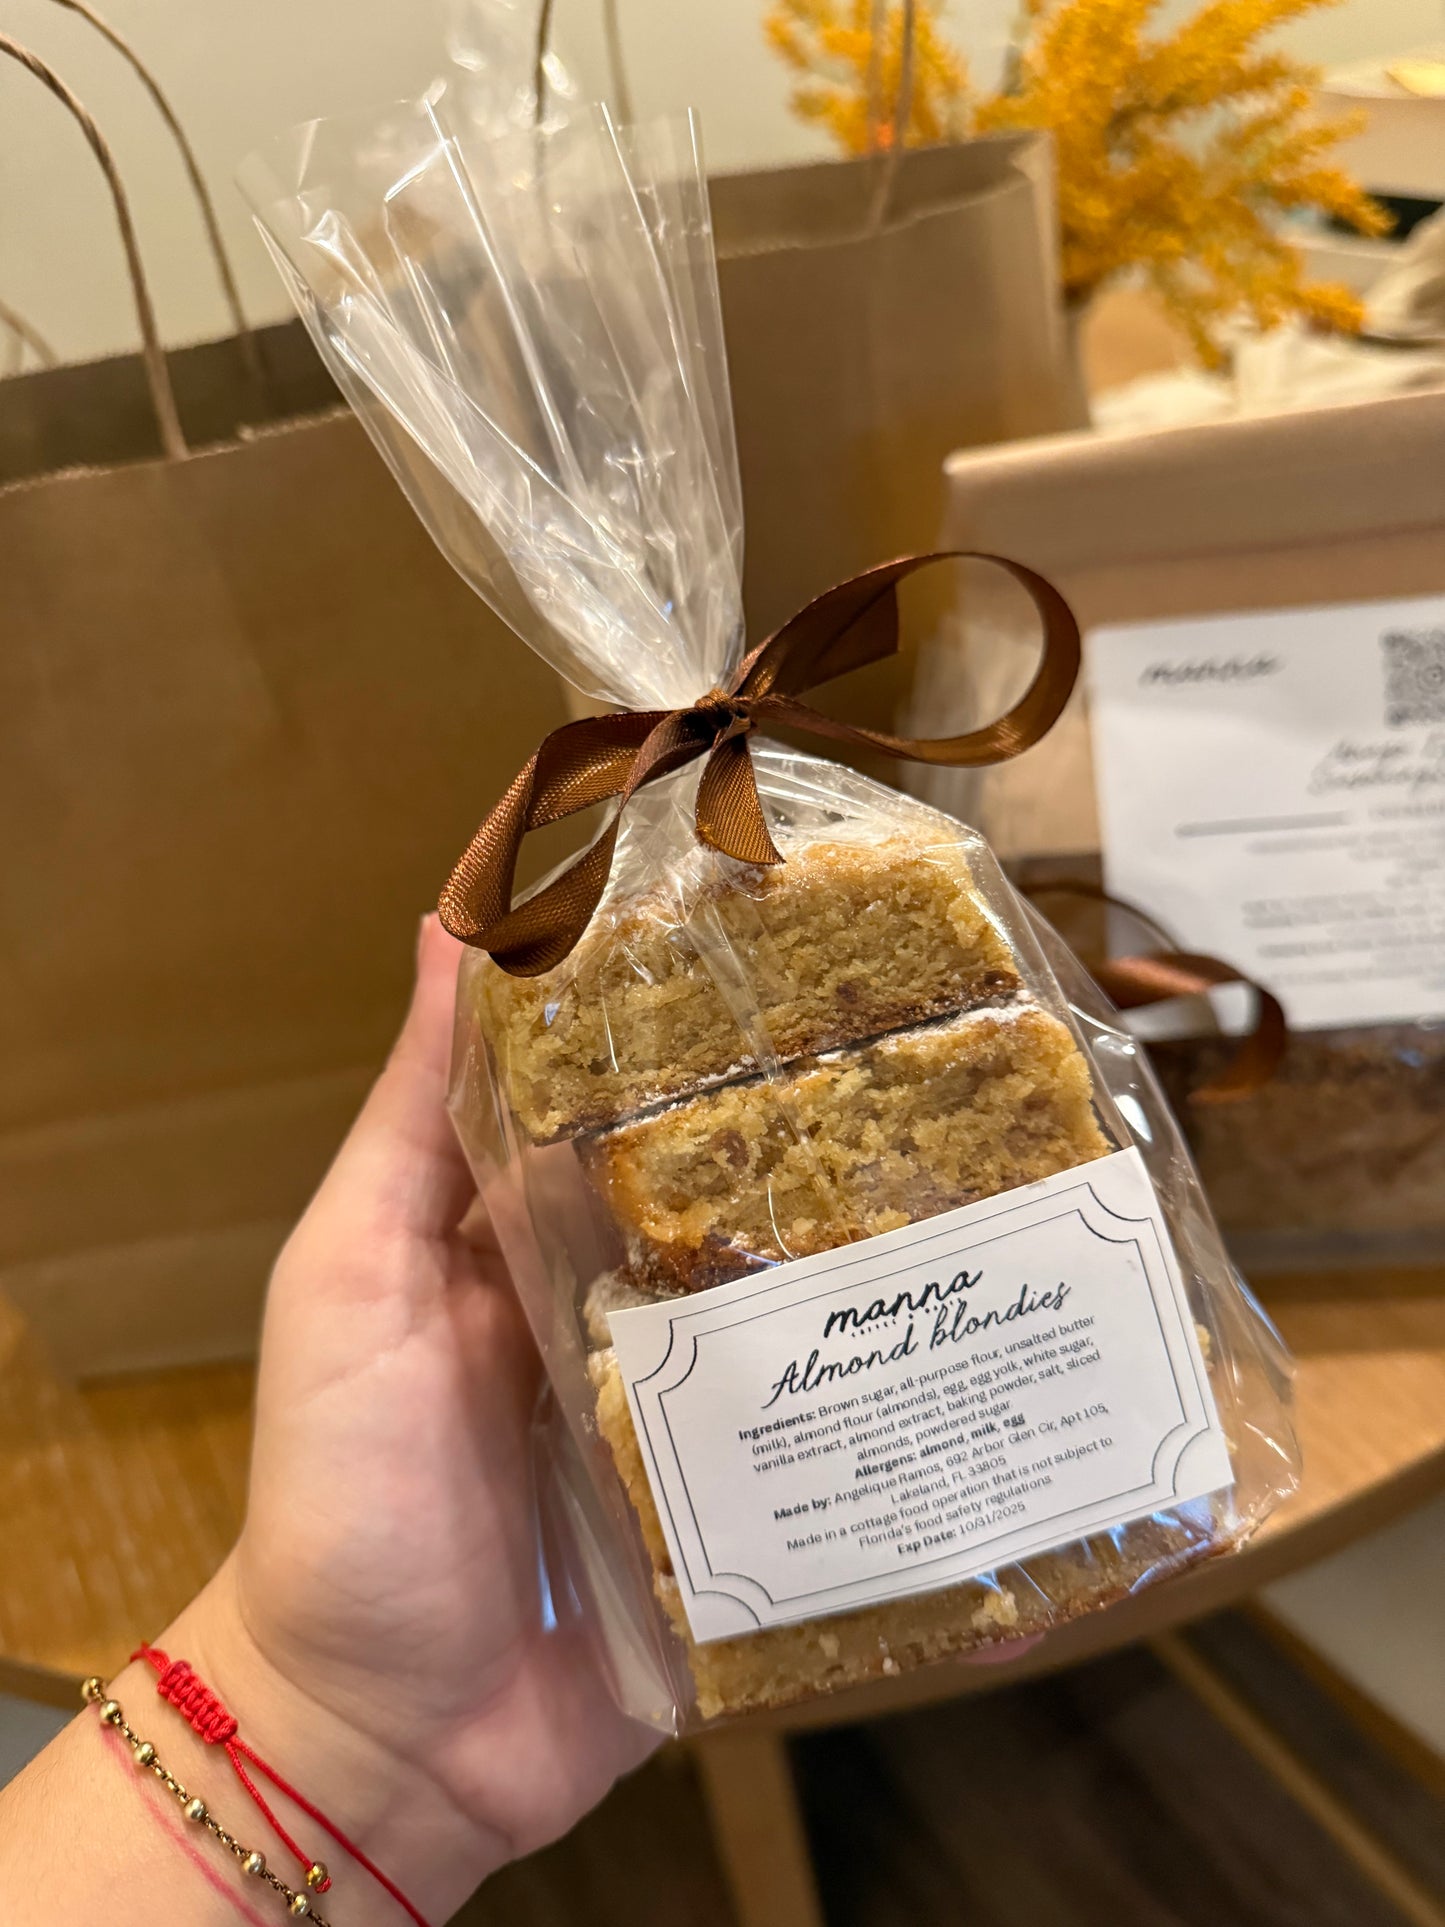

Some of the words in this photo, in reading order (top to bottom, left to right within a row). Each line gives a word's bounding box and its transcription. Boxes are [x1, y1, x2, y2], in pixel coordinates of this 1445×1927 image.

[761, 1323, 919, 1409] Almond
[929, 1281, 1072, 1350] blondies
[823, 1270, 983, 1338] manna
[738, 1411, 817, 1441] Ingredients:
[818, 1398, 860, 1418] Brown
[861, 1384, 898, 1404] sugar,
[900, 1360, 969, 1391] all-purpose
[971, 1351, 1003, 1367] flour,
[1004, 1328, 1057, 1354] unsalted
[1058, 1314, 1095, 1334] butter
[752, 1436, 791, 1456] (milk),
[794, 1420, 841, 1444] almond
[843, 1411, 873, 1429] flour
[876, 1388, 941, 1418] (almonds),
[969, 1369, 991, 1386] egg
[993, 1359, 1022, 1377] yolk,
[1023, 1349, 1057, 1367] white
[1059, 1336, 1094, 1355] sugar,
[753, 1455, 795, 1473] vanilla
[797, 1439, 847, 1460] extract,
[849, 1422, 896, 1446] almond
[899, 1405, 946, 1429] extract,
[947, 1390, 986, 1412] baking
[989, 1373, 1037, 1399] powder,
[1038, 1363, 1064, 1380] salt,
[1066, 1349, 1101, 1370] sliced
[773, 1503, 809, 1520] Made
[812, 1497, 832, 1511] by:
[834, 1477, 897, 1504] Angelique
[899, 1462, 944, 1483] Ramos,
[946, 1451, 969, 1467] 692
[972, 1440, 1006, 1459] Arbor
[1008, 1428, 1036, 1445] Glen
[1038, 1420, 1058, 1433] Cir,
[1061, 1411, 1082, 1427] Apt
[1083, 1402, 1109, 1418] 105,
[855, 1451, 917, 1478] Allergens:
[920, 1435, 969, 1458] almond,
[970, 1424, 1001, 1440] milk,
[1003, 1412, 1026, 1428] egg
[857, 1434, 913, 1461] almonds,
[915, 1409, 977, 1441] powdered
[891, 1476, 950, 1503] Lakeland,
[951, 1471, 967, 1484] FL
[968, 1455, 1007, 1477] 33805
[786, 1534, 822, 1550] Made
[825, 1528, 837, 1541] in
[840, 1527, 847, 1536] a
[850, 1511, 899, 1533] cottage
[900, 1501, 929, 1518] food
[931, 1481, 990, 1511] operation
[992, 1468, 1016, 1486] that
[1018, 1464, 1029, 1477] is
[1031, 1457, 1052, 1473] not
[1054, 1441, 1099, 1463] subject
[1100, 1436, 1112, 1448] to
[859, 1523, 912, 1548] Florida's
[914, 1513, 943, 1531] food
[946, 1500, 982, 1521] safety
[985, 1474, 1052, 1506] regulations
[897, 1539, 921, 1555] Exp
[923, 1529, 957, 1547] Date:
[959, 1501, 1026, 1534] 10/31/2025
